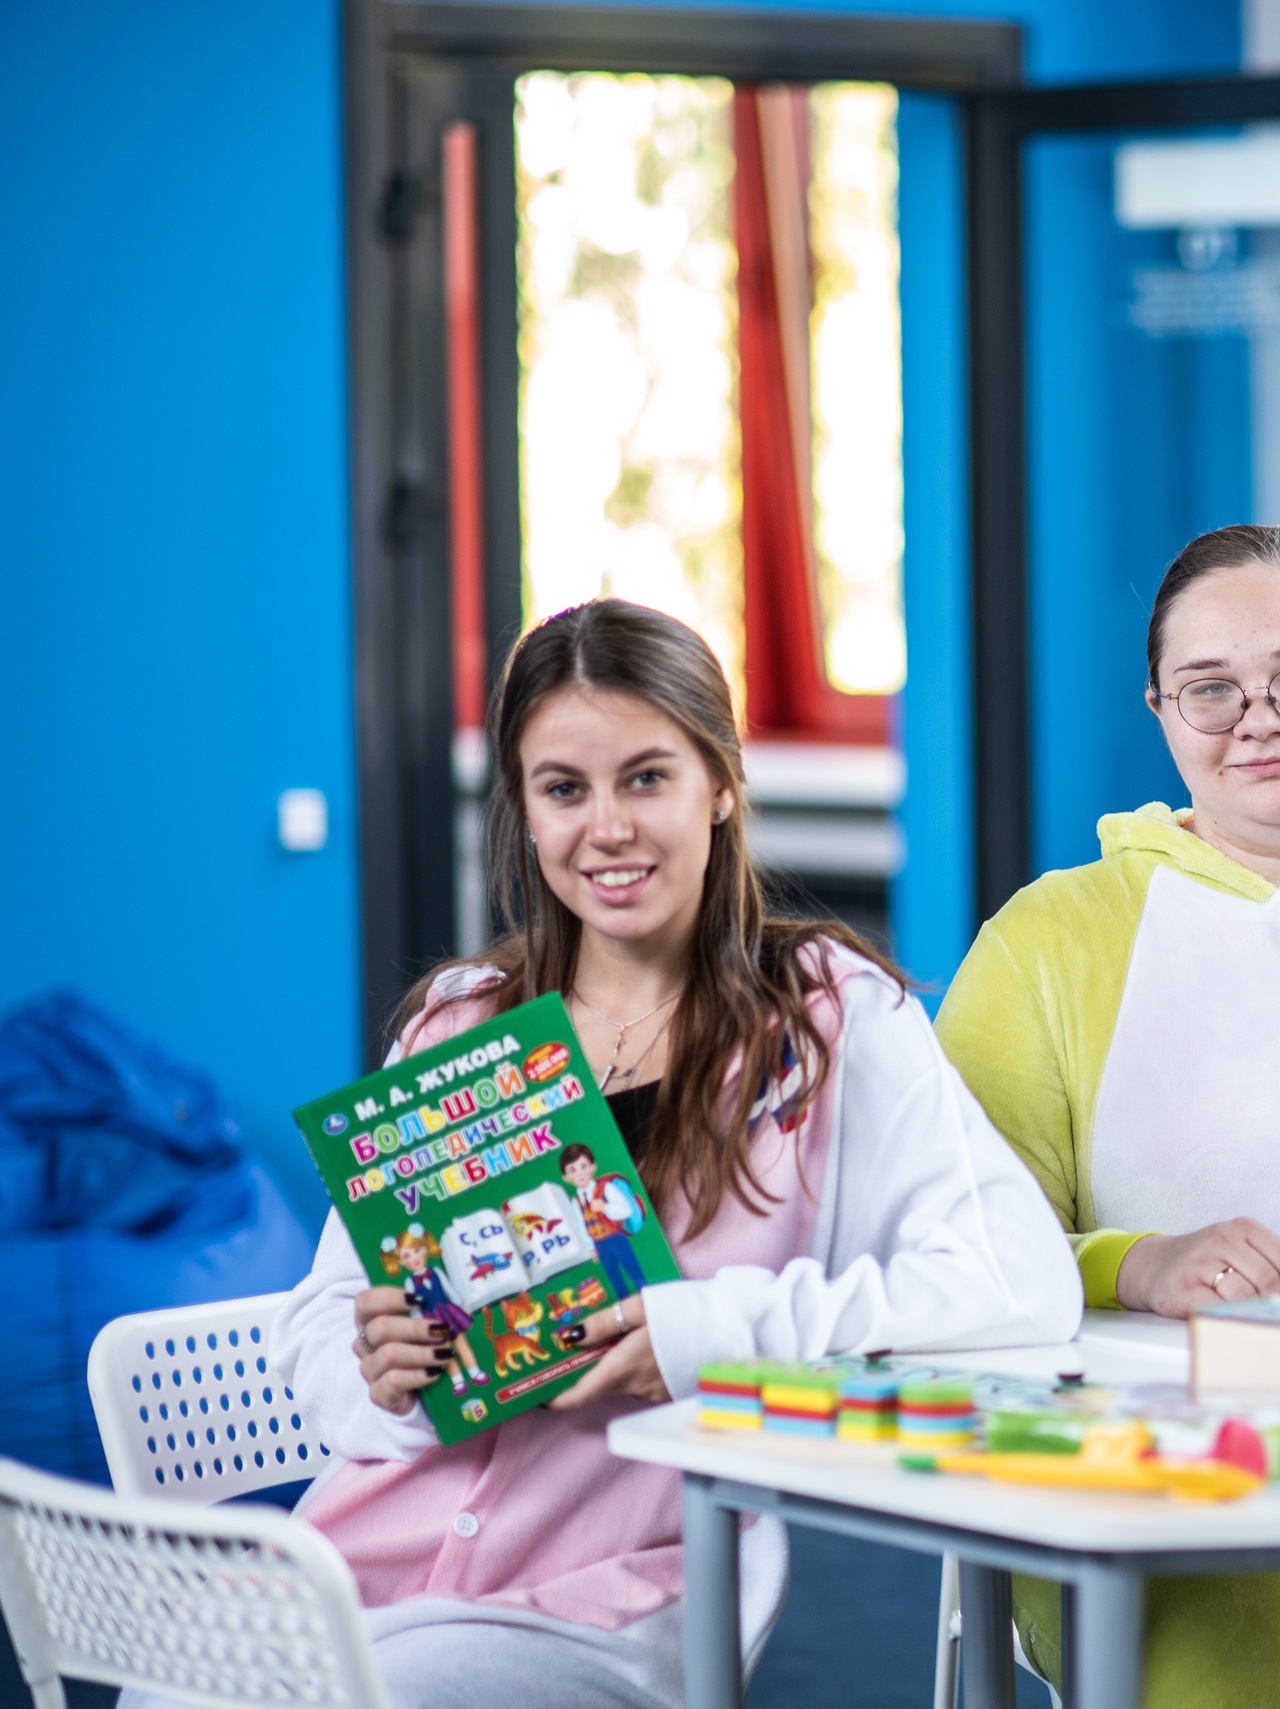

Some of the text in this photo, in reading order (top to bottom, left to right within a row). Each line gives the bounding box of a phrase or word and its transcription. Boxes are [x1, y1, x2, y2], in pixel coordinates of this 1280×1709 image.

[350, 1061, 526, 1165] БОЛЬШОЙ
[354, 1097, 385, 1121] М.
[389, 1085, 414, 1107] А.
[415, 1034, 521, 1094] ЖУКОВА
[347, 1073, 585, 1201] ЛОГОПЕДИЧЕСКИЙ
[394, 1121, 562, 1214] УЧЕБНИК
[480, 1224, 503, 1239] СЬ
[541, 1235, 570, 1254] РЬ
